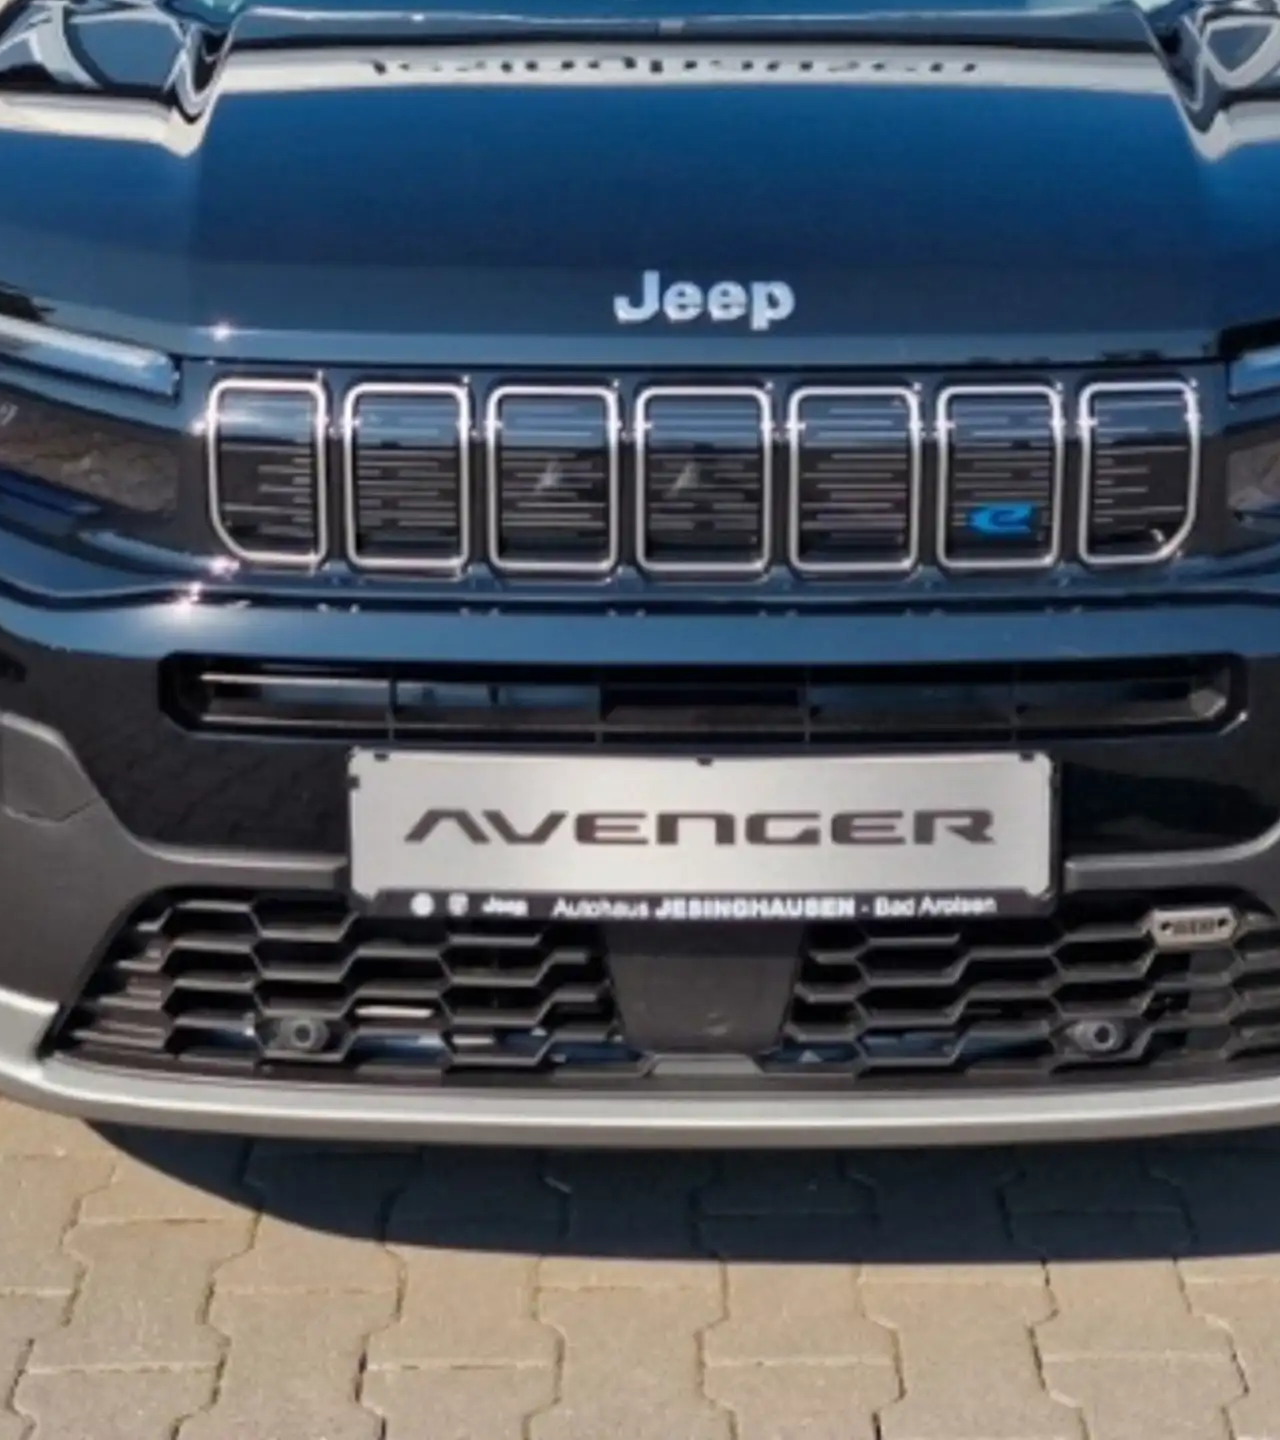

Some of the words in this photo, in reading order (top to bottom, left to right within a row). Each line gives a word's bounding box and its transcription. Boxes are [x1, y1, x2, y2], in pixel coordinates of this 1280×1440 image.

[613, 271, 795, 330] Jeep
[405, 808, 997, 846] AVENGER
[550, 897, 650, 919] Autohaus
[654, 895, 856, 919] JESINGHAUSEN
[874, 895, 916, 917] Bad
